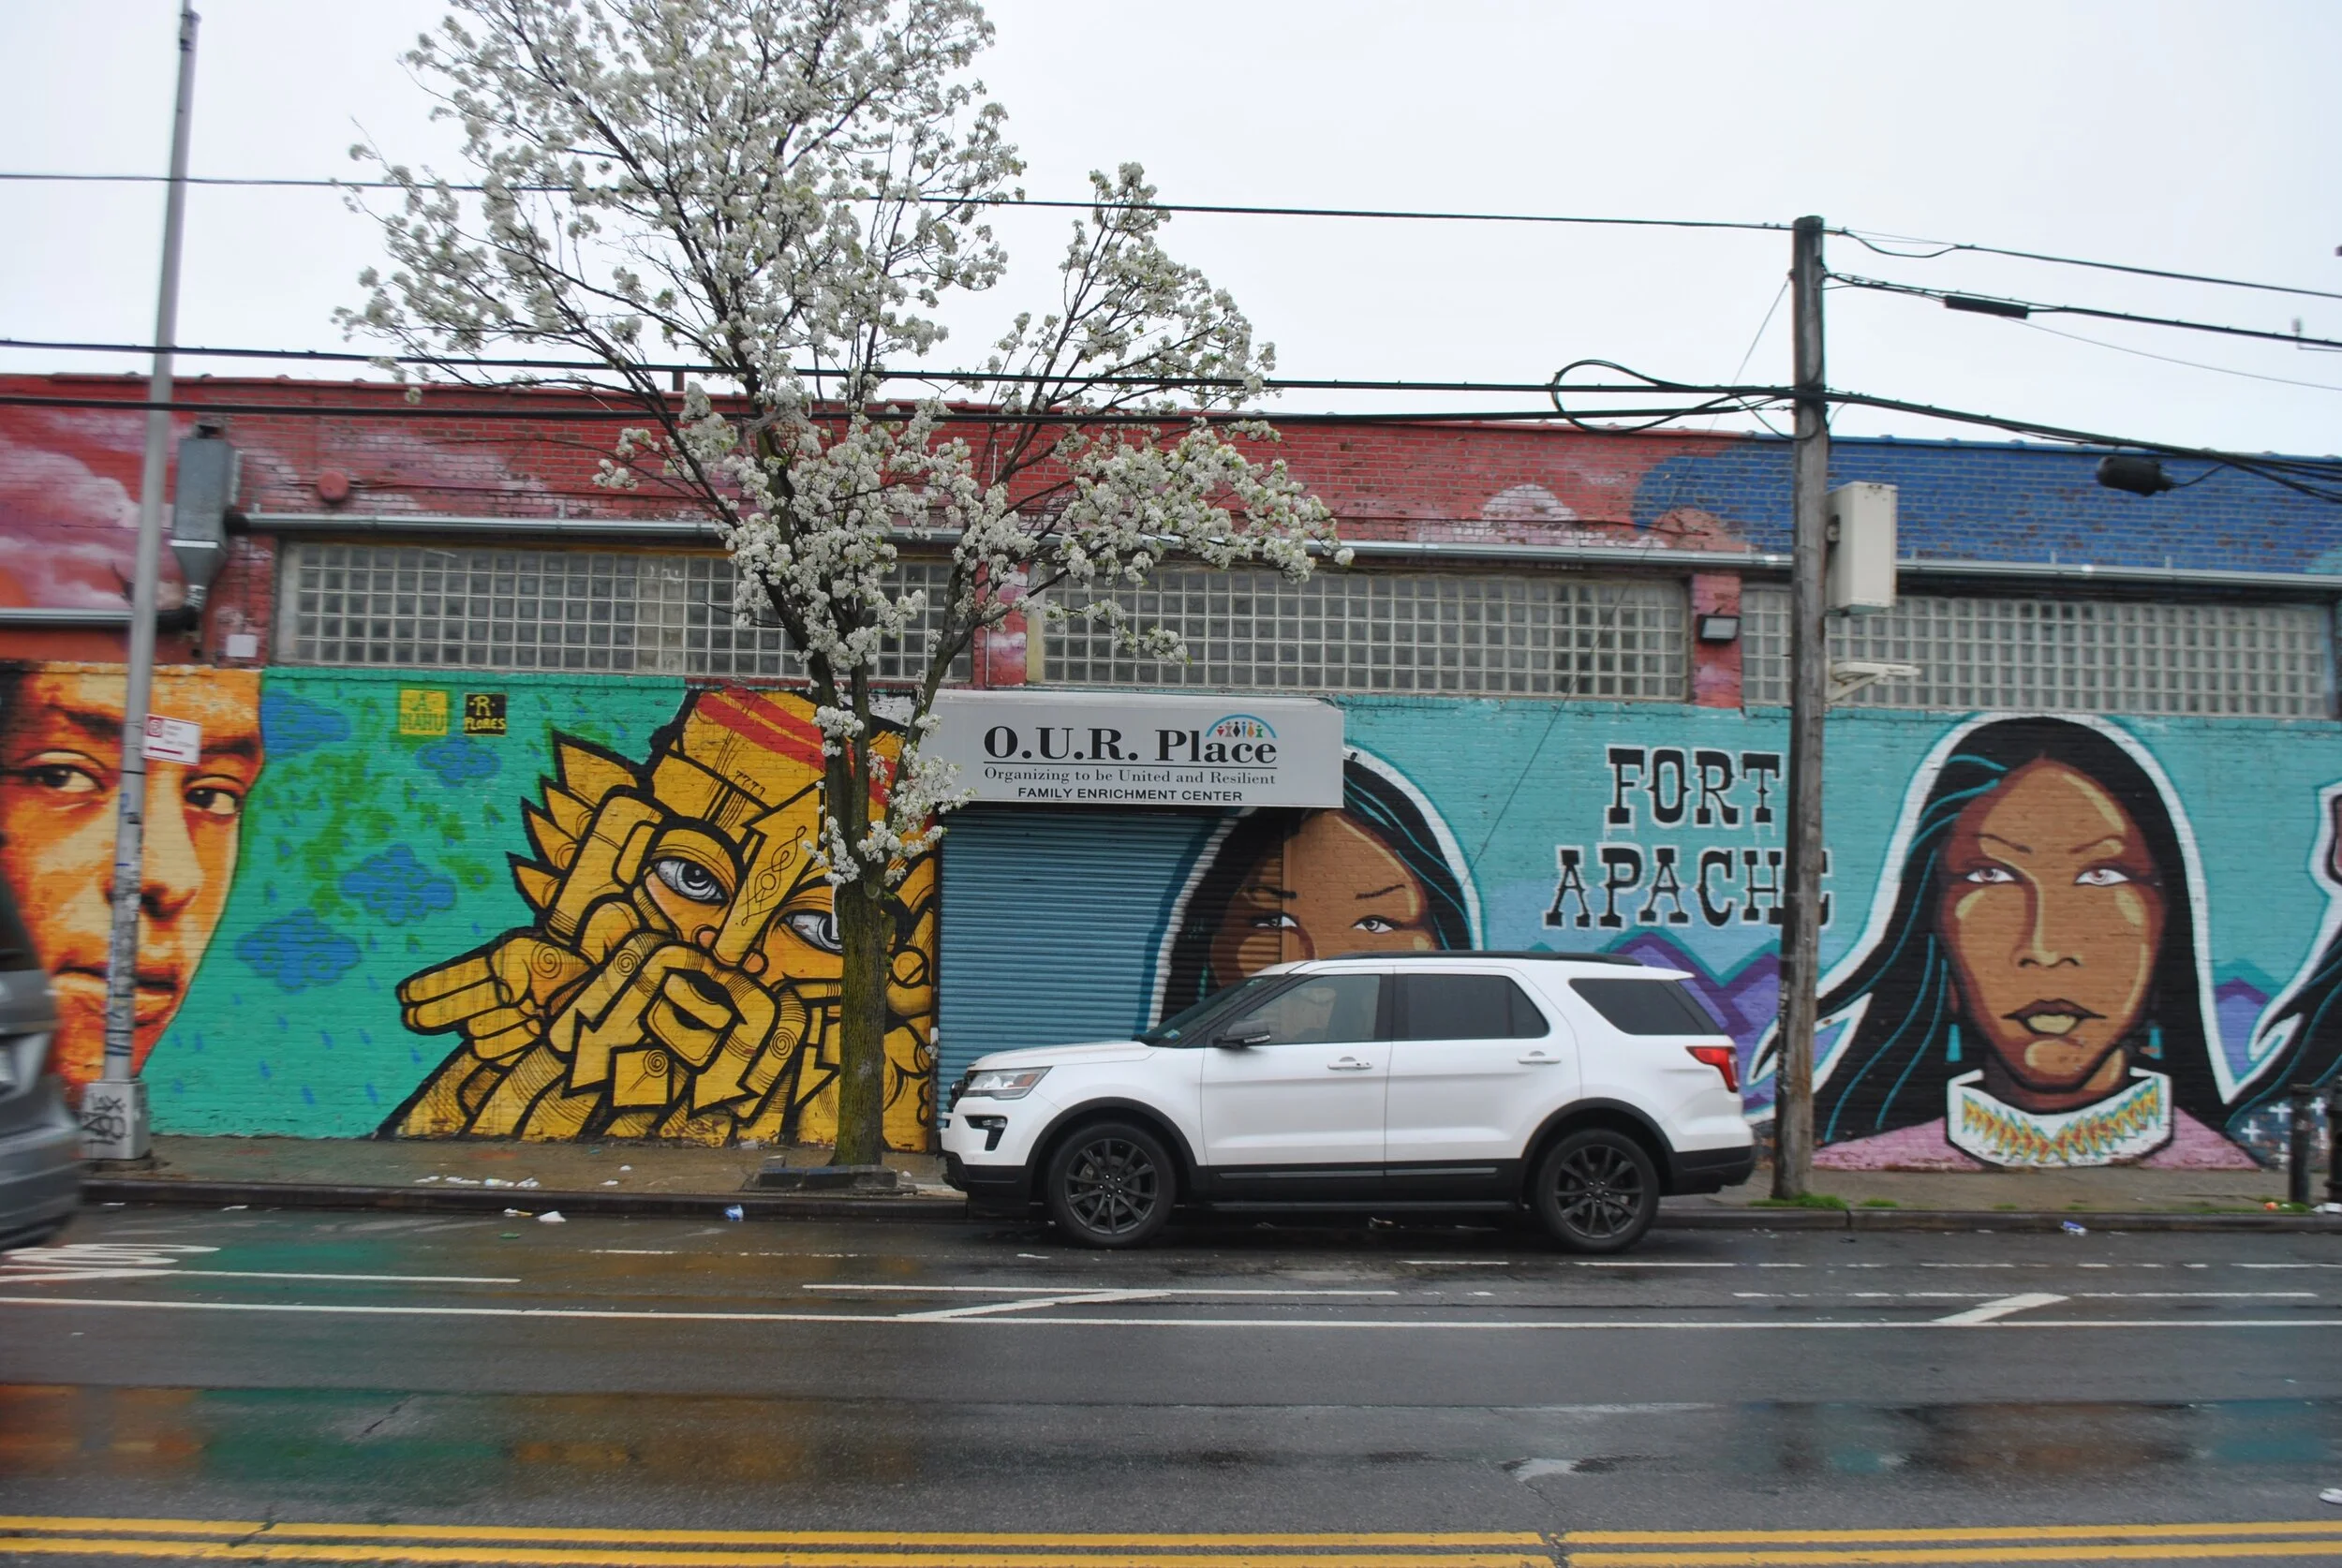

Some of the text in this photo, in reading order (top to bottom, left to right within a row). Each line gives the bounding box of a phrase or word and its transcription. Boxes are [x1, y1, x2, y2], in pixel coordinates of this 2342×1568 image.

[984, 725, 1278, 764] O.U.R. Place
[984, 766, 1276, 785] Organizing to be United and Resilient
[1017, 787, 1243, 802] FAMILY ENRICHMENT CENTER
[1608, 747, 1781, 826] FORT
[1545, 846, 1829, 928] APACH
